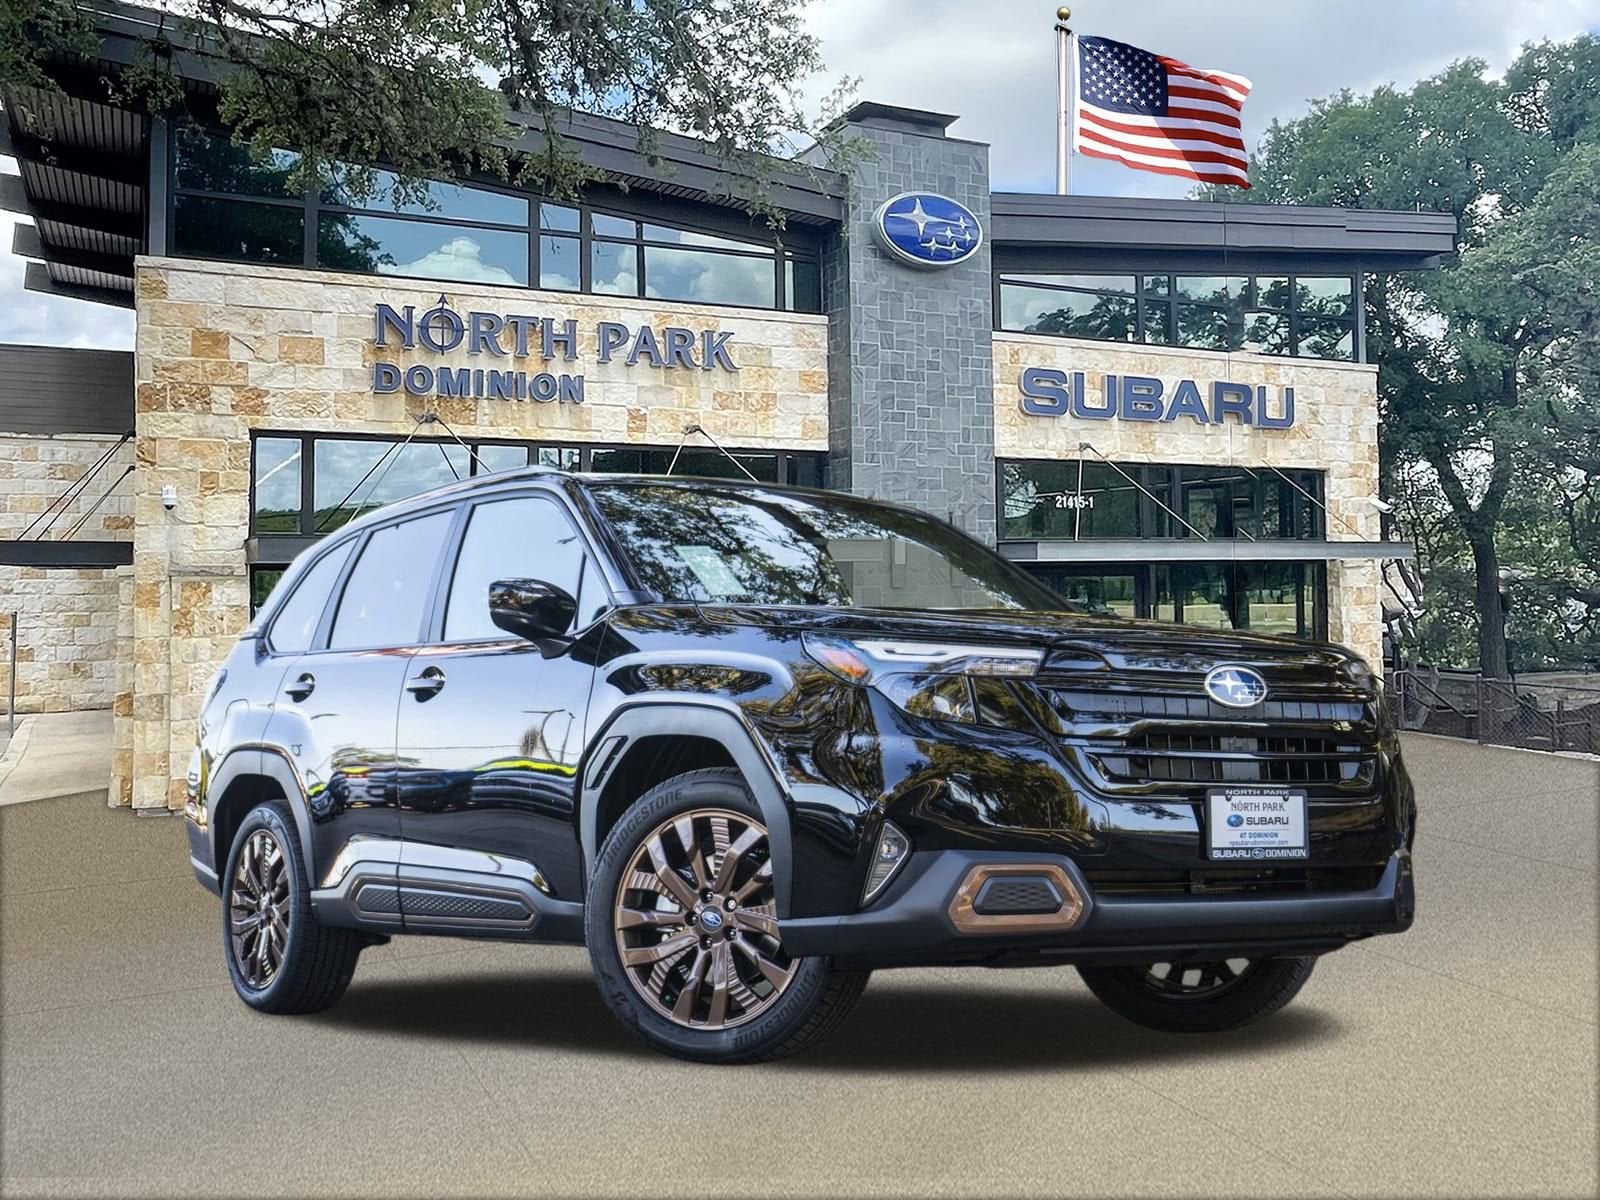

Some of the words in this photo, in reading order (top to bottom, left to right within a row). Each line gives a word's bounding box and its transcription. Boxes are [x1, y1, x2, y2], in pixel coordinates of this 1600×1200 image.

[375, 300, 578, 361] NORTH
[597, 321, 741, 373] PARK
[373, 362, 585, 404] DOMINION
[1019, 366, 1296, 429] SUBARU
[1055, 495, 1094, 509] 21415-1
[1231, 801, 1260, 811] NORTH
[1263, 802, 1285, 811] PARK
[1246, 816, 1289, 825] SUBARU
[1212, 849, 1251, 858] SUBARU
[1266, 849, 1306, 857] DOMINION
